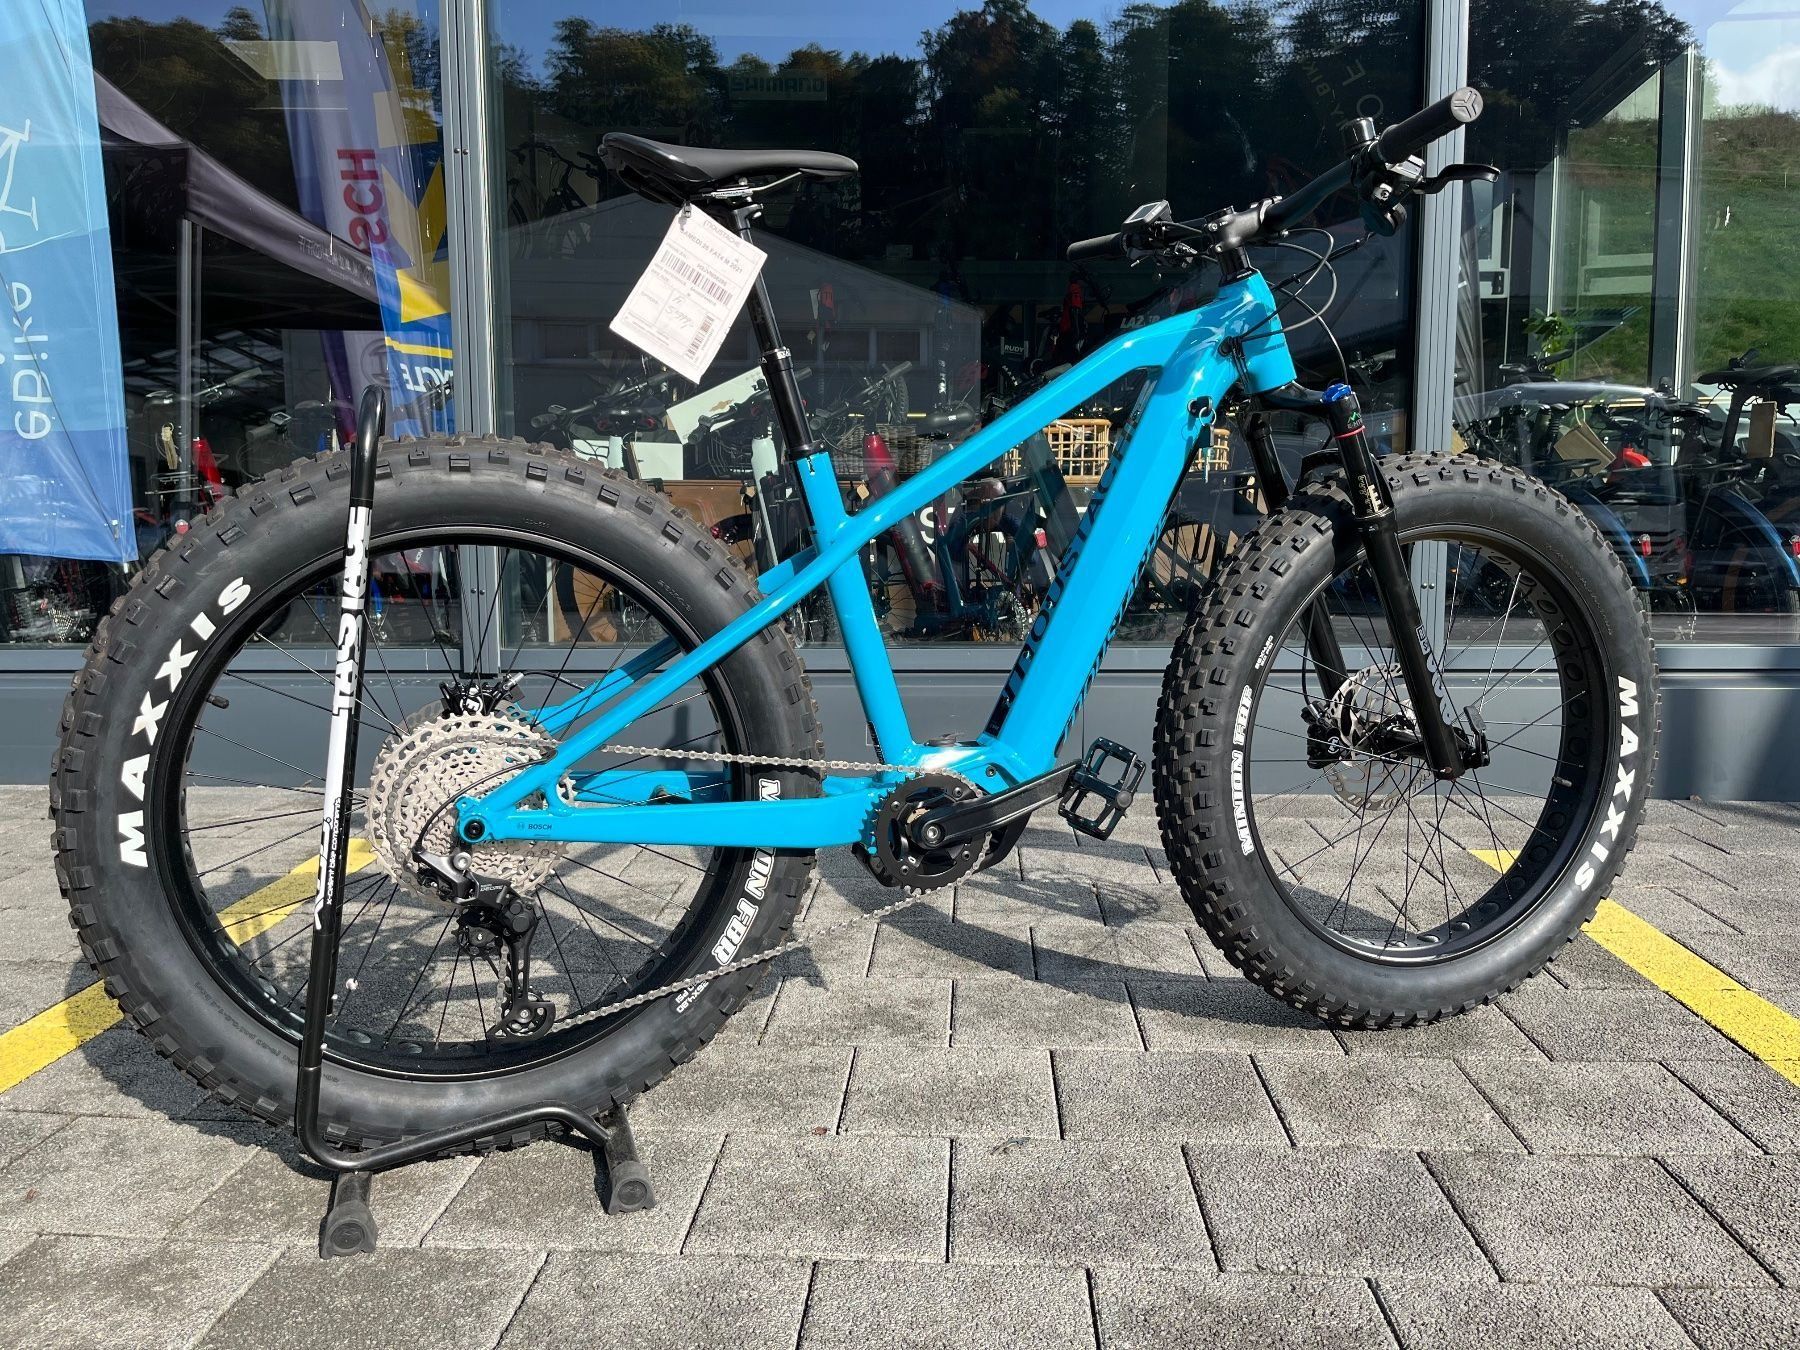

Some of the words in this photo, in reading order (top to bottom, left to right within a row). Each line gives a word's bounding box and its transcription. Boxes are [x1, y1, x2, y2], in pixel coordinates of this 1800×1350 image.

[1004, 345, 1025, 353] RUDY
[118, 577, 252, 868] MAXXIS
[1230, 749, 1255, 856] MINION
[1574, 675, 1641, 893] MAXXIS
